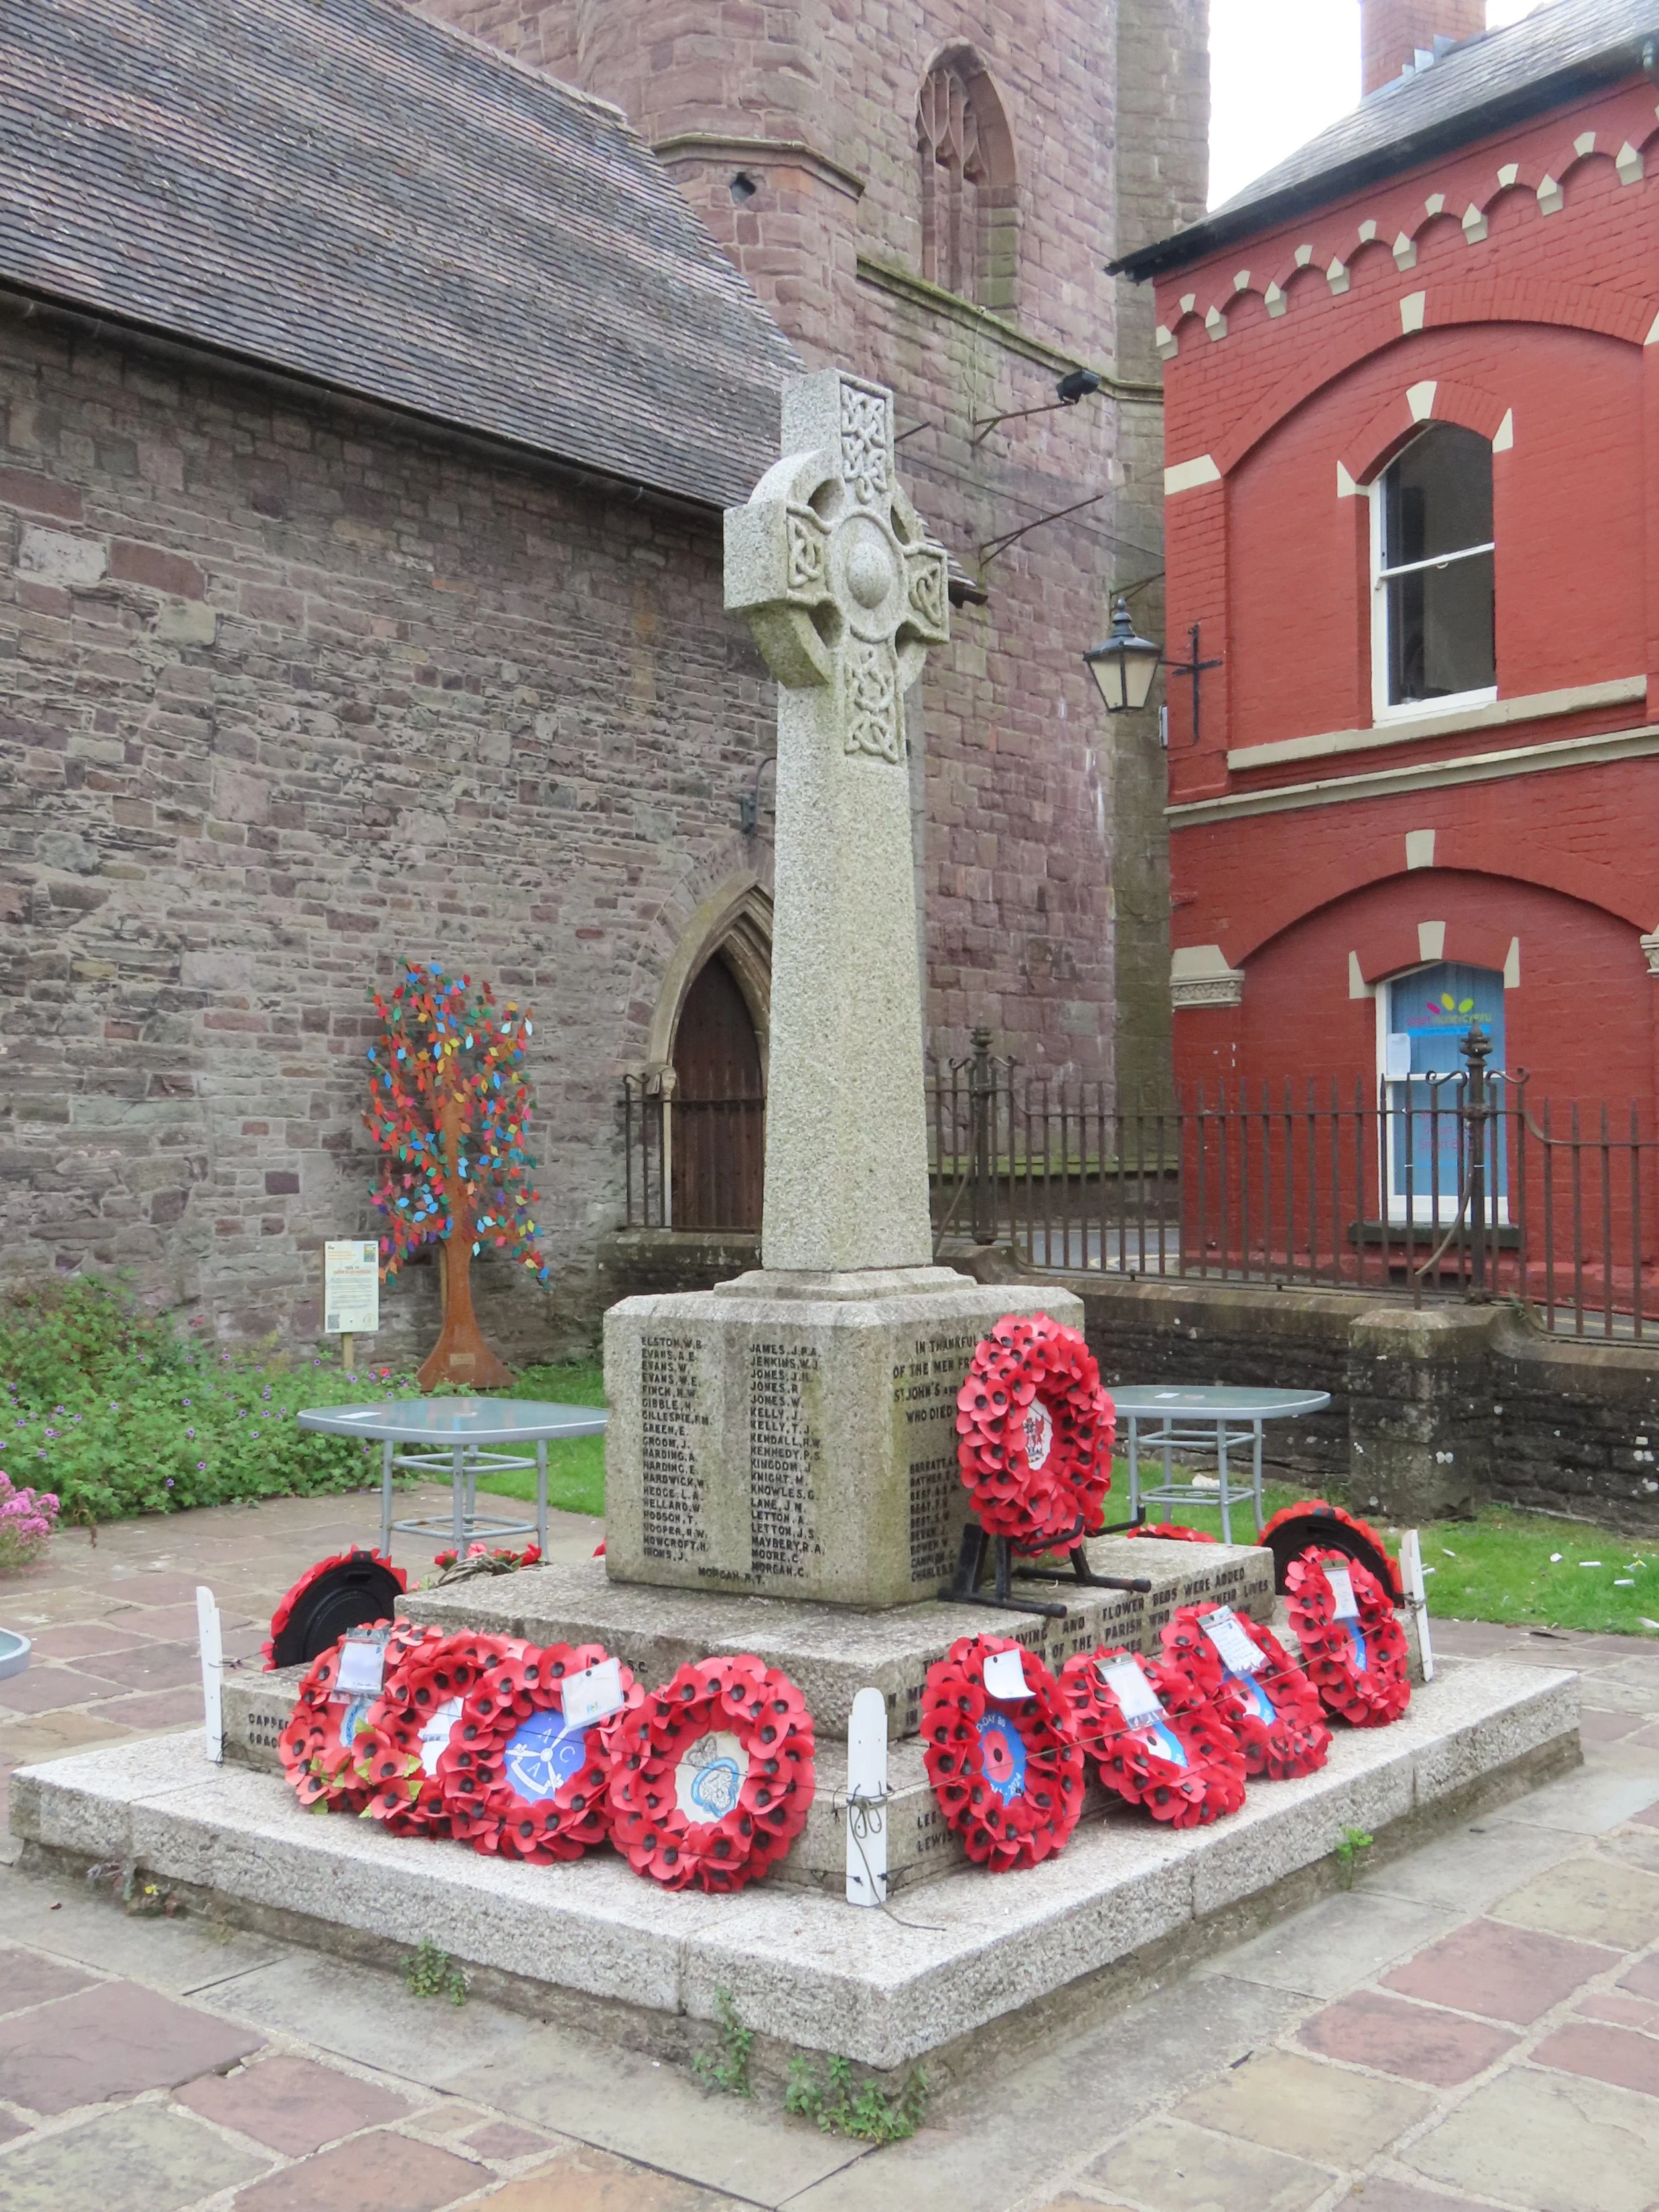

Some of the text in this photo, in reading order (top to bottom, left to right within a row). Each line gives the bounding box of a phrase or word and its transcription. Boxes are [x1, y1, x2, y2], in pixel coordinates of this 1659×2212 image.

[929, 1334, 977, 1353] THANKFUL
[910, 1362, 929, 1377] THE
[934, 1359, 954, 1372] MEN
[906, 1404, 953, 1424] WHO DIED
[1009, 1567, 1246, 1646] AVING AND FLOWER BEDS WERE ADDED
[1052, 1643, 1064, 1659] OF
[1072, 1635, 1092, 1653] THE
[1105, 1618, 1142, 1642] PARISH
[1149, 1609, 1170, 1627] WHO
[1244, 1579, 1268, 1598] LIVES
